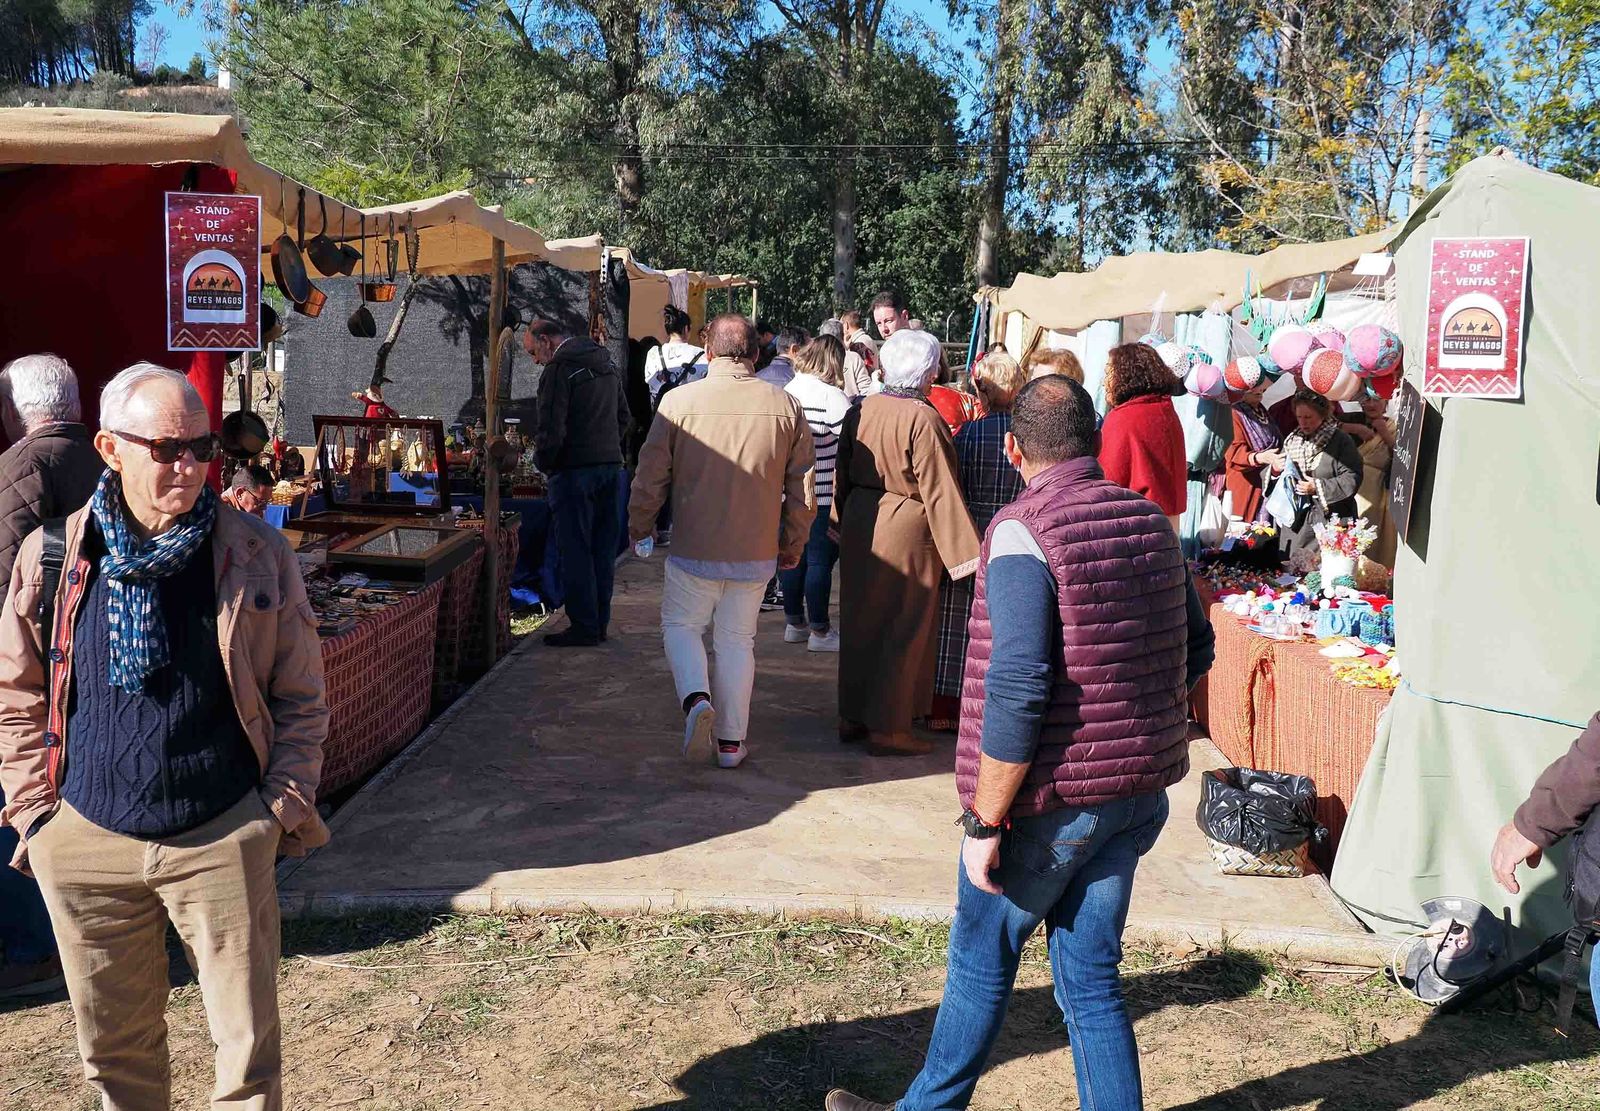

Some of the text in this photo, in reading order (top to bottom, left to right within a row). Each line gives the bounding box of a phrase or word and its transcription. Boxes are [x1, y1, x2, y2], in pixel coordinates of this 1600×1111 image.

[195, 205, 230, 216] STAND
[206, 220, 220, 229] DE
[194, 233, 234, 243] VENTAS
[1458, 249, 1495, 259] STAND
[1468, 263, 1483, 272] DE
[1456, 277, 1497, 286] VENTAS
[187, 295, 242, 305] REYES MAGOS
[1443, 340, 1502, 350] REYES MAGOS
